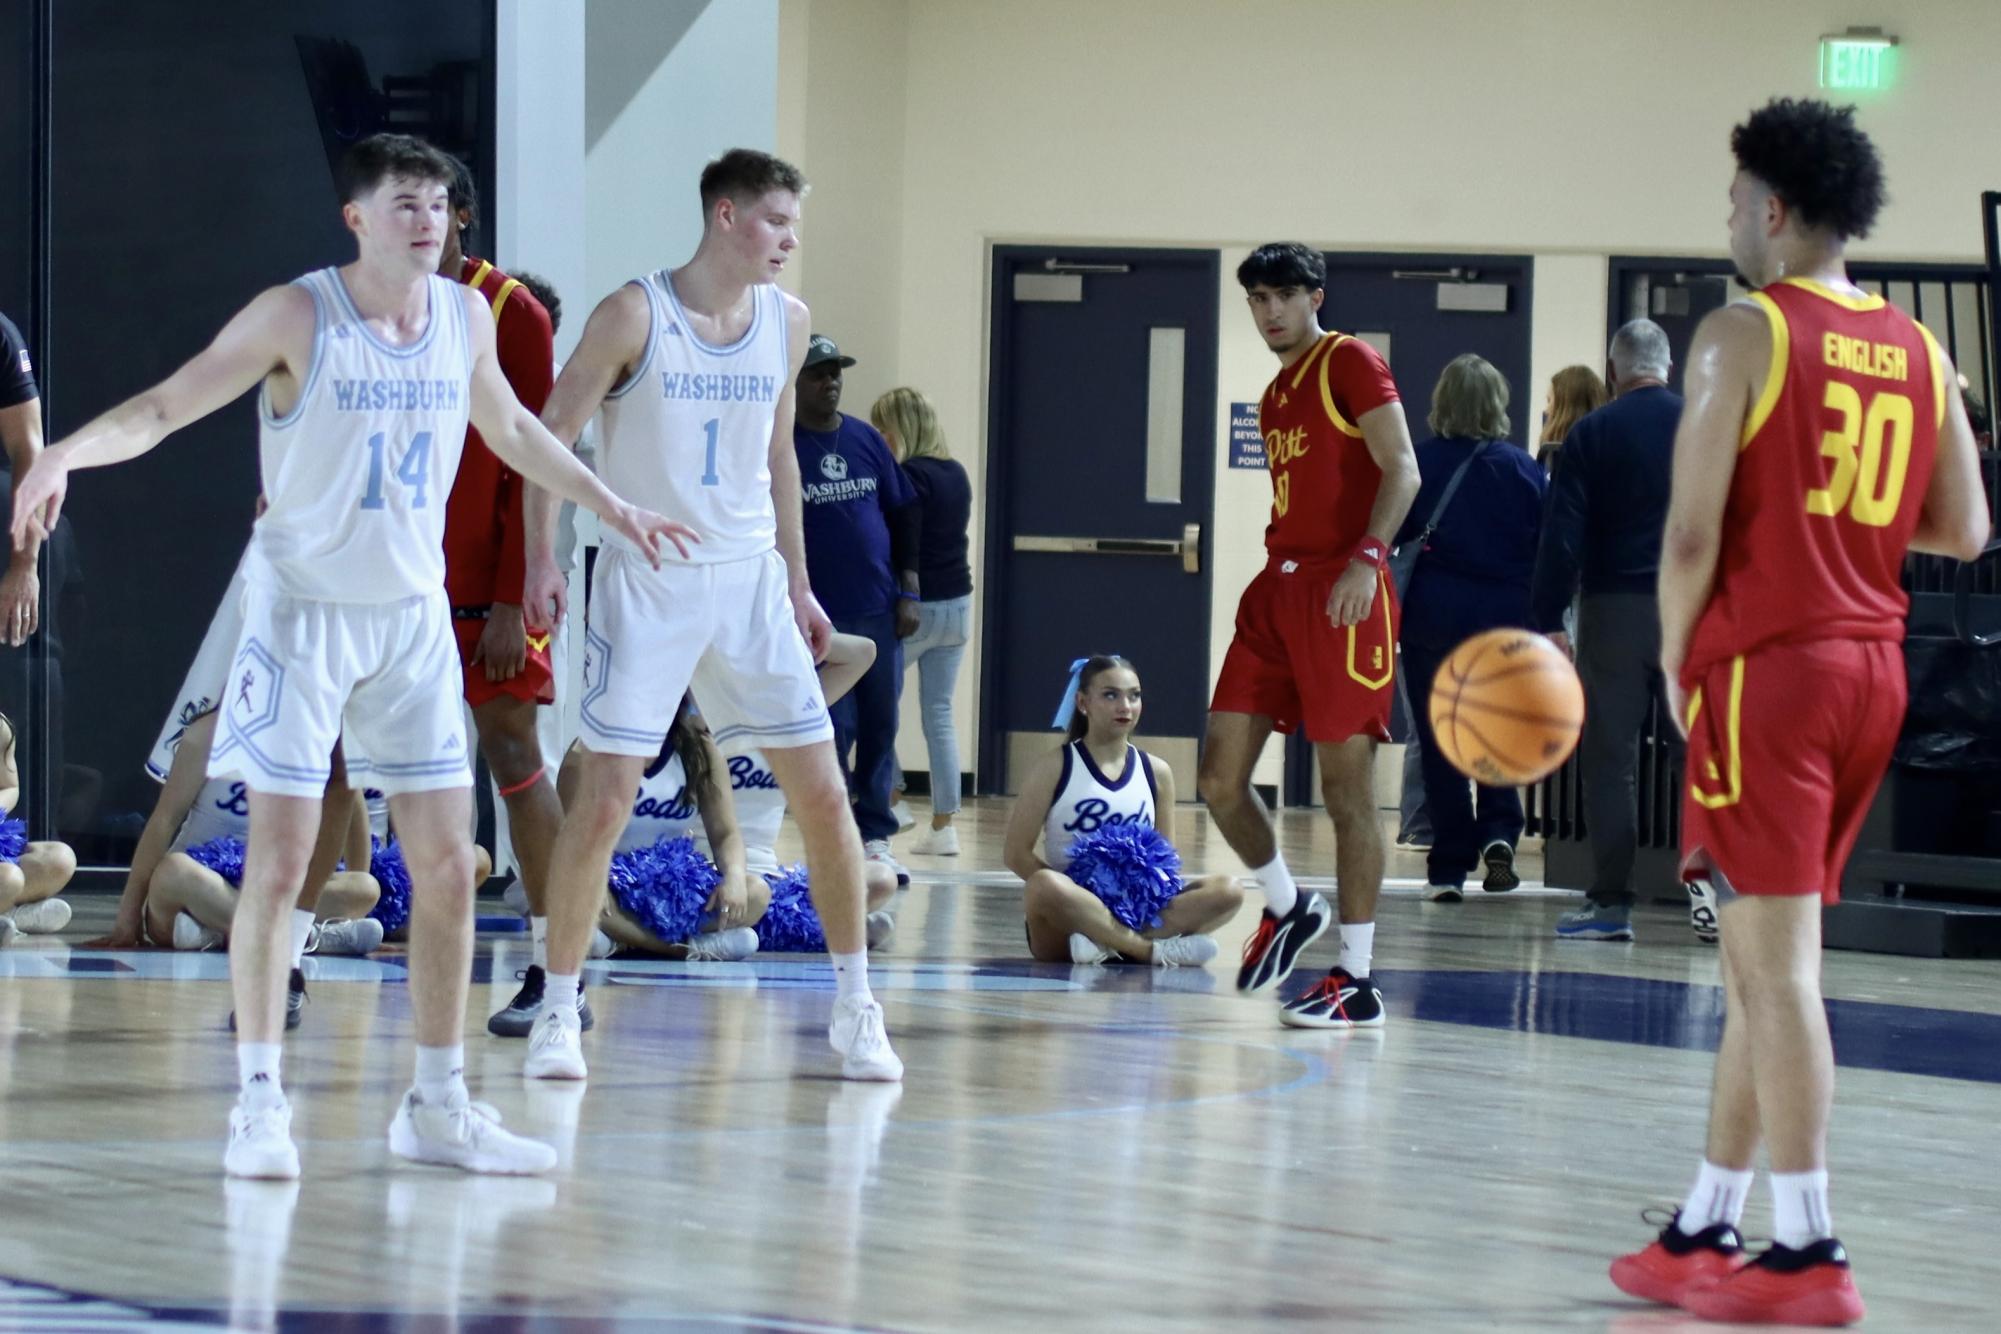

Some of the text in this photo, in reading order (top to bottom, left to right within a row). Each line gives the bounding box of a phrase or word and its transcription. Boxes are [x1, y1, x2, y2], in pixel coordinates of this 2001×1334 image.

[1830, 46, 1883, 88] EXIT
[1823, 332, 1907, 381] ENGLISH
[332, 379, 459, 411] WASHBURN
[662, 372, 775, 402] WASHBURN
[1232, 418, 1259, 426] ALCO
[700, 417, 719, 485] 1
[1238, 457, 1266, 466] POINT
[1242, 444, 1263, 453] THIS
[1266, 425, 1310, 469] Pitt
[1806, 381, 1914, 527] 30
[360, 431, 432, 510] 14
[814, 491, 866, 505] UNIVERSITY
[633, 786, 695, 820] ods
